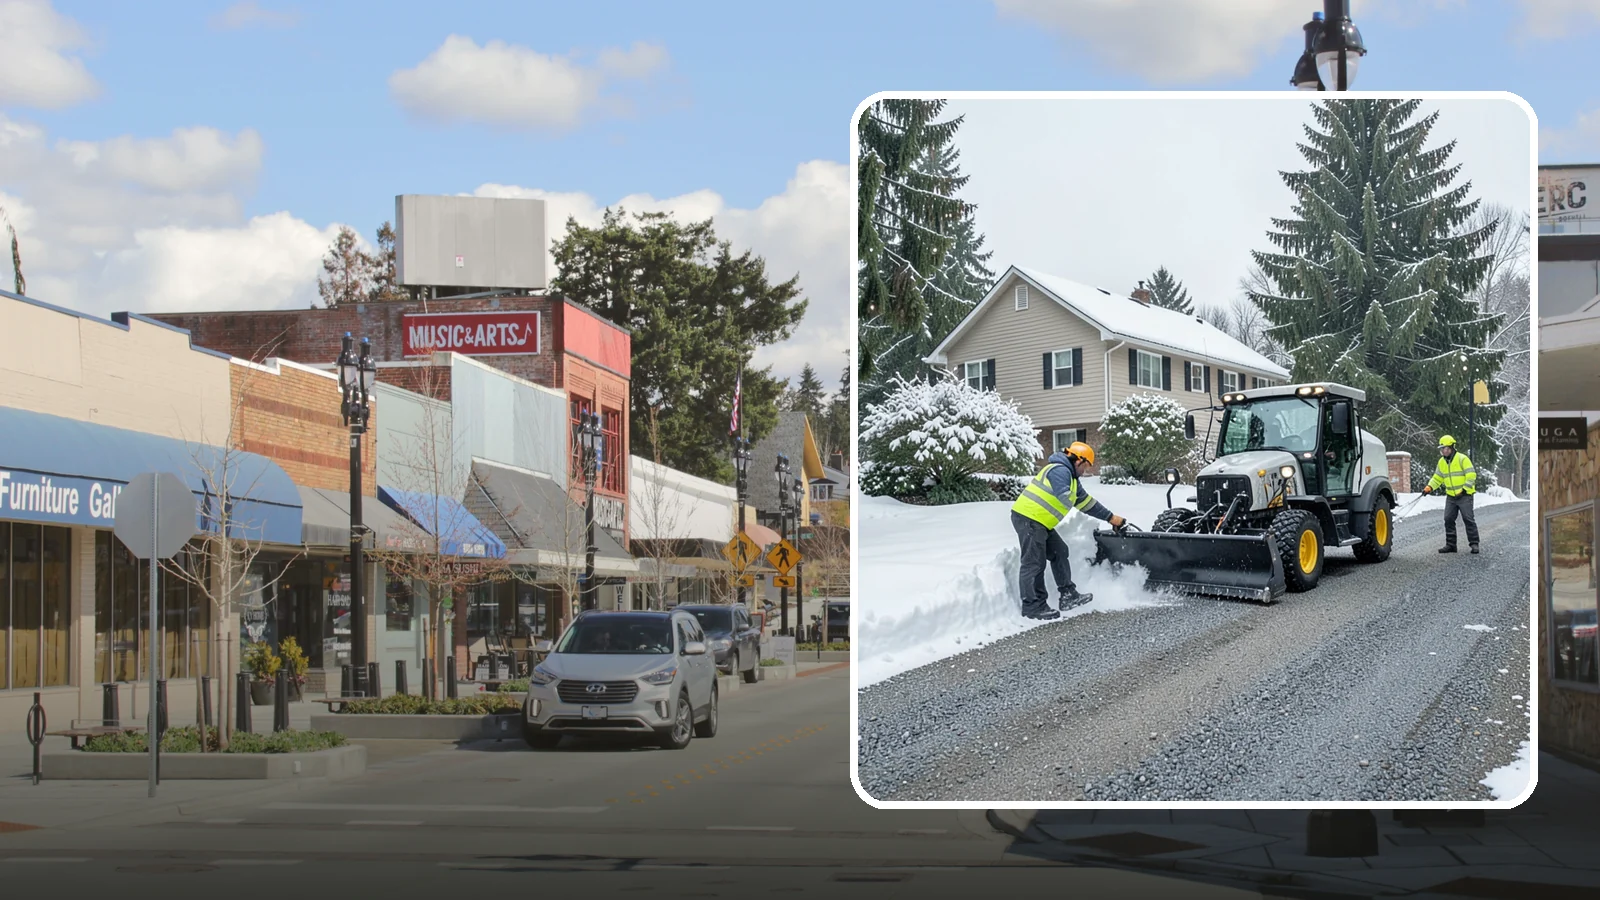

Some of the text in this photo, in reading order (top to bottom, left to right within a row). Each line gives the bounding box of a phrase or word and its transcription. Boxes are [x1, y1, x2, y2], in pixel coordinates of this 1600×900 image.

[409, 323, 519, 348] MUSIC&ARTS
[0, 472, 121, 519] Furniture Gal
[453, 563, 480, 574] SUSHI
